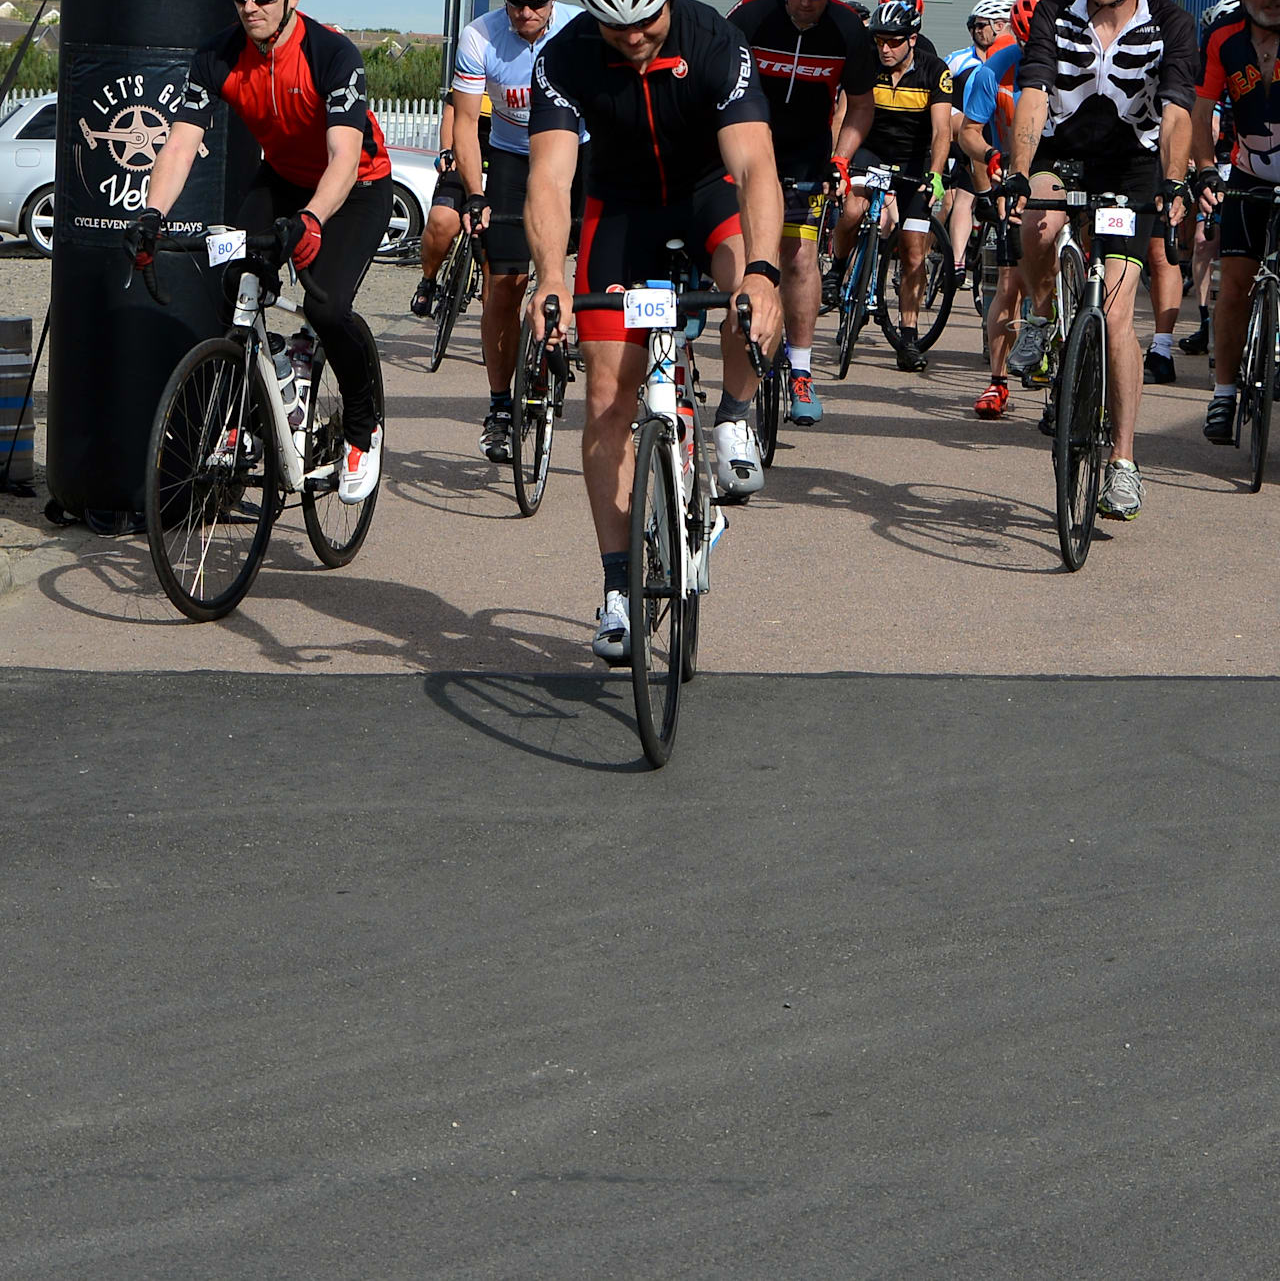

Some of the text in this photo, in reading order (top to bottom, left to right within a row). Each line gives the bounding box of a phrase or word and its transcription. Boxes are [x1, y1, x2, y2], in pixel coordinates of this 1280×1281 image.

[756, 58, 834, 77] TREK
[92, 74, 144, 115] LET'S
[74, 217, 100, 229] CYCLE
[1107, 217, 1124, 228] 28
[217, 241, 233, 255] 80
[635, 302, 665, 317] 105
